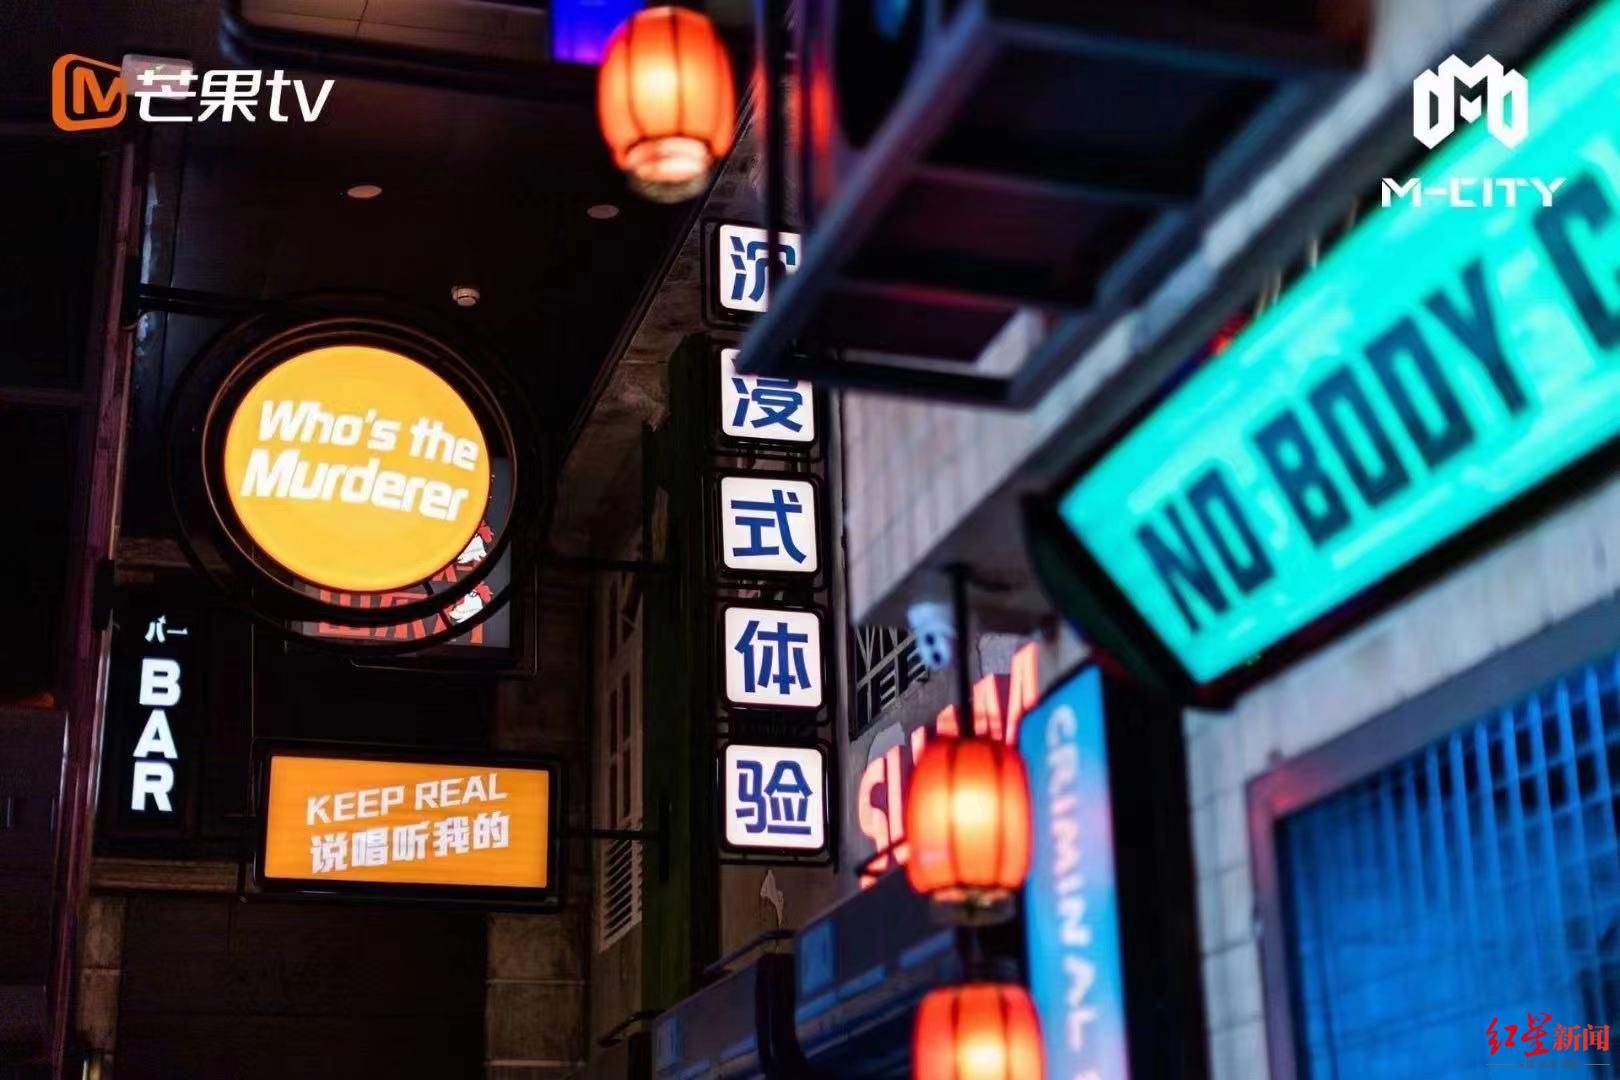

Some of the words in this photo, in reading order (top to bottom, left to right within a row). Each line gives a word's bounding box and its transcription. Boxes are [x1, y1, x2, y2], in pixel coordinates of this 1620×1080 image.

[258, 400, 401, 451] Who's
[409, 416, 479, 472] the
[1135, 468, 1275, 632] NO
[1252, 256, 1530, 548] BODY
[240, 448, 468, 522] Murderer
[131, 657, 181, 812] BAR
[306, 785, 406, 826] KEEP
[415, 773, 508, 811] REAL
[310, 810, 511, 874] 说唱听我的
